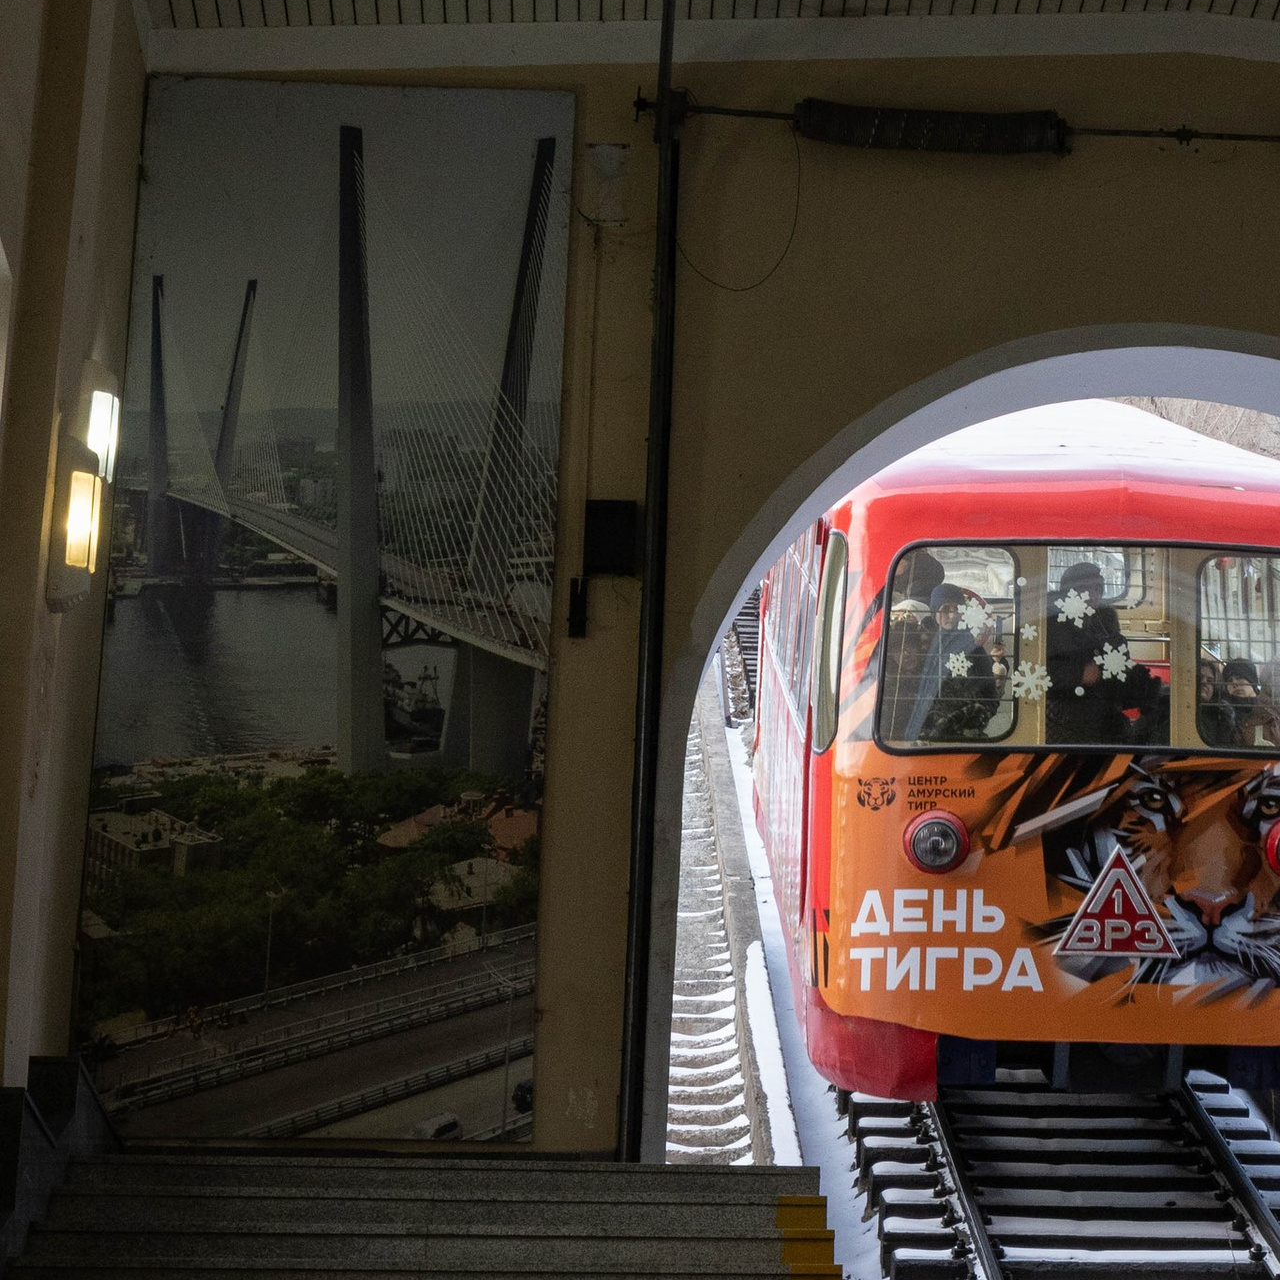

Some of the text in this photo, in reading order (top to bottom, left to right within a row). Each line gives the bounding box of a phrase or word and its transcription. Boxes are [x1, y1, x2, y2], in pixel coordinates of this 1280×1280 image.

[908, 776, 948, 787] ЦЕНТР
[908, 787, 976, 798] АМУРСКИЙ
[908, 801, 938, 811] ТИГР
[850, 888, 1005, 938] ДЕНЬ
[1065, 918, 1164, 951] ВРЗ
[849, 946, 1044, 993] ТИГРА
